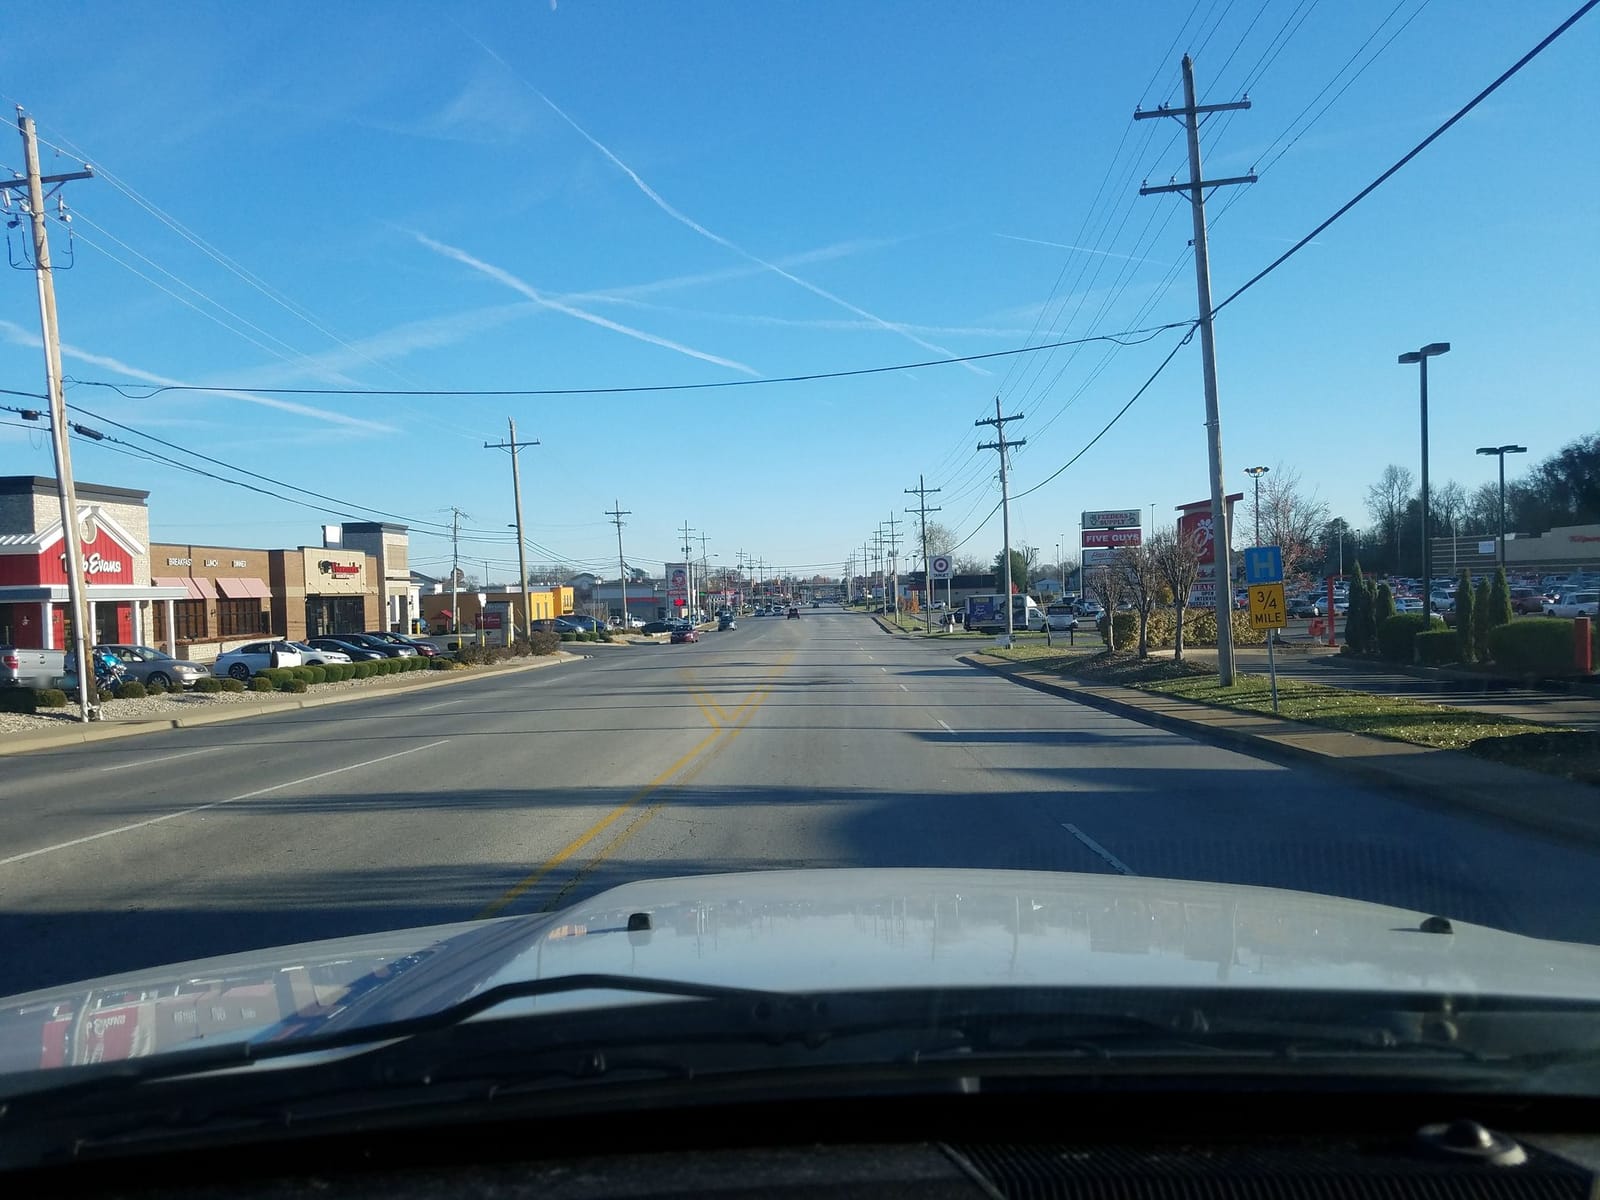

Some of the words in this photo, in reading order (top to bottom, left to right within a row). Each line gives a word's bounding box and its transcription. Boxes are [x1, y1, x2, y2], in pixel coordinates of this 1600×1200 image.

[1112, 533, 1139, 542] GUYS
[88, 553, 121, 574] Evans
[1252, 551, 1276, 578] H
[1257, 590, 1277, 610] 3/4
[1255, 613, 1282, 624] MILE
